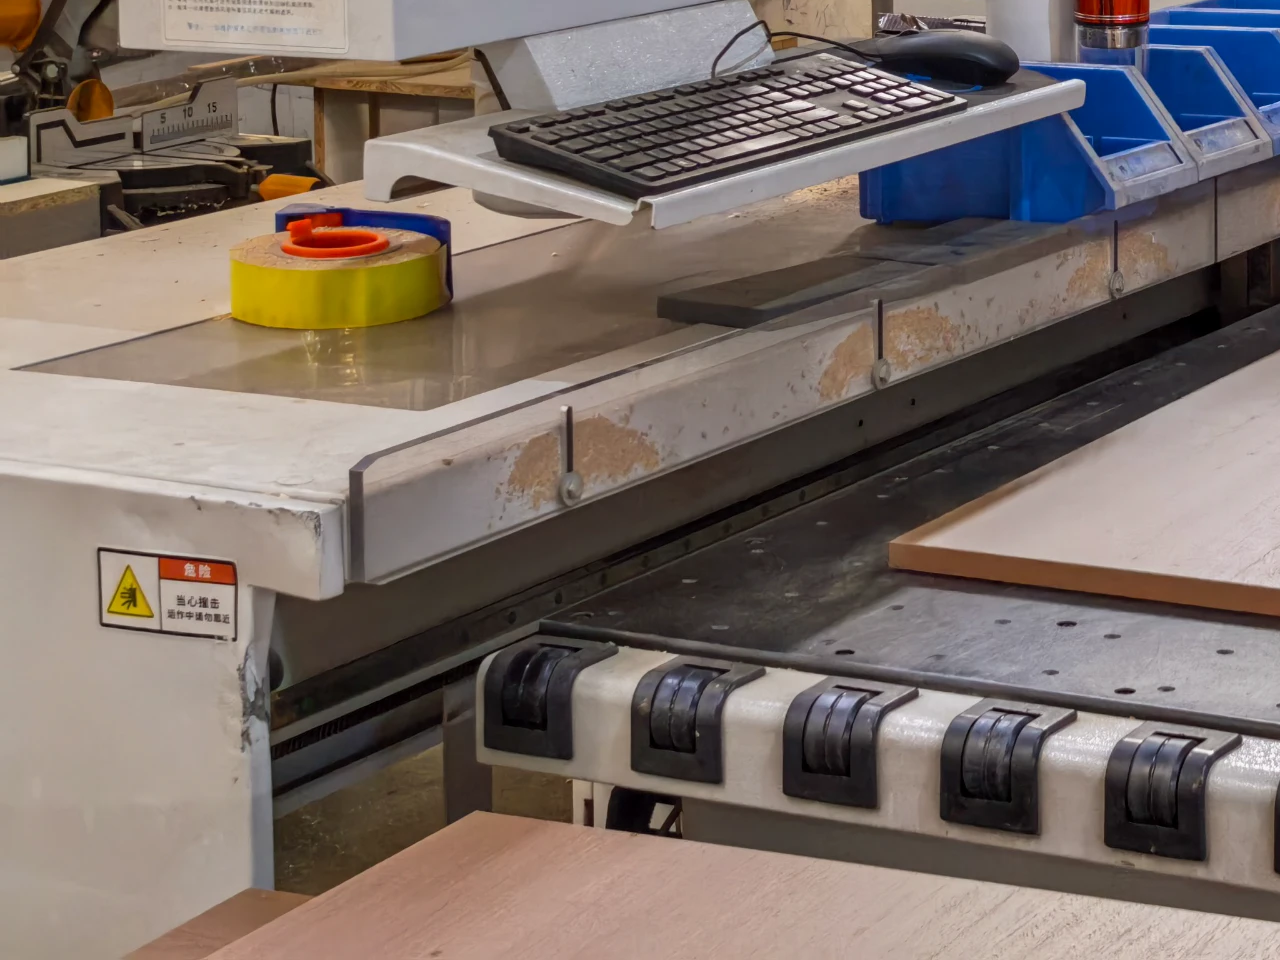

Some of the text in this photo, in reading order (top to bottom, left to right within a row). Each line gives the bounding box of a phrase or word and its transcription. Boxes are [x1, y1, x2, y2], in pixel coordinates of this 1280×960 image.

[160, 102, 218, 124] 5 10 15
[184, 563, 211, 579] 危险
[176, 594, 220, 610] 当心撞击
